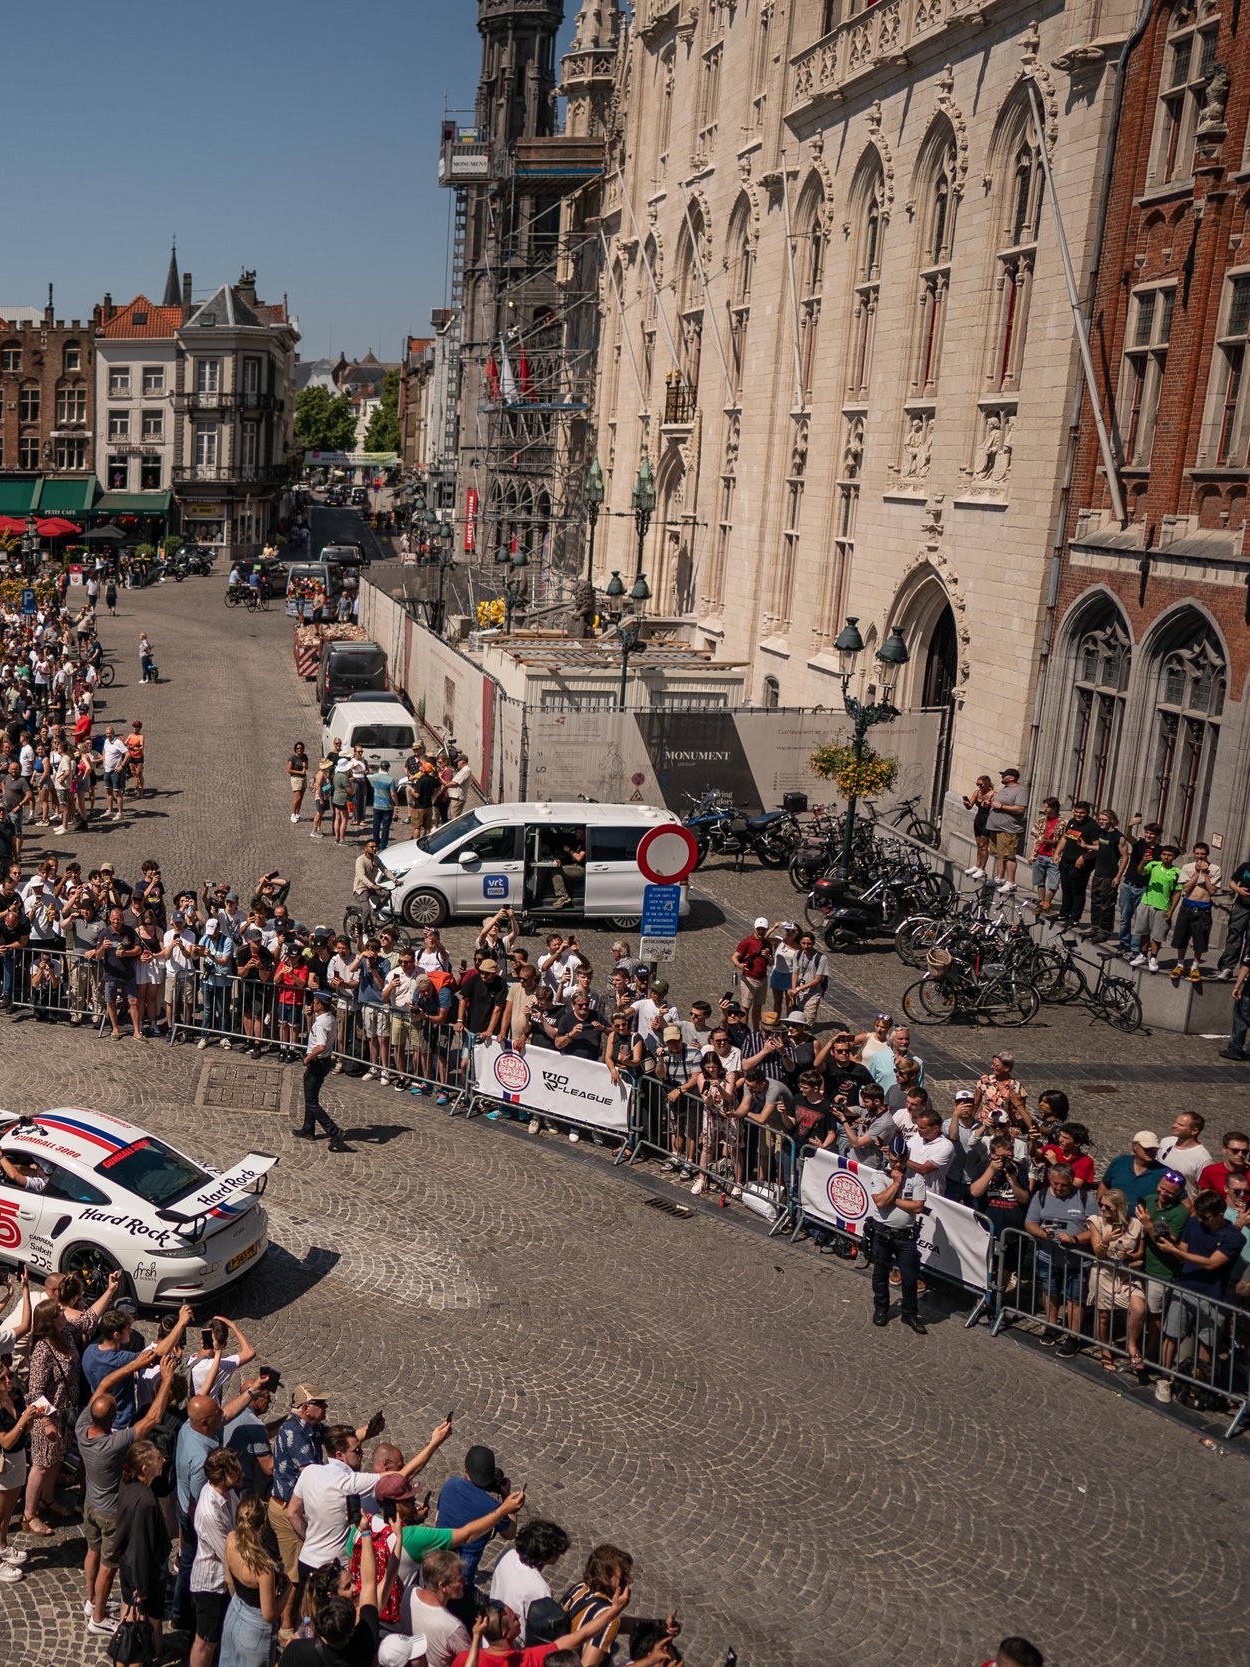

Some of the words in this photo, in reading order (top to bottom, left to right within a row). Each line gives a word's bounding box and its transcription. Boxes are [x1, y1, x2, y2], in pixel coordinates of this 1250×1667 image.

[24, 592, 34, 605] P
[665, 751, 731, 760] MONUMENT
[488, 878, 504, 887] vrt
[544, 1080, 614, 1106] R-LEAGUE
[14, 1134, 55, 1150] GUMBALL
[55, 1145, 82, 1159] 3000
[102, 1146, 134, 1169] GUMBALL
[197, 1183, 228, 1206] Hard
[226, 1169, 260, 1192] Rock
[78, 1207, 130, 1226] Hard
[124, 1217, 171, 1248] Rock
[29, 1234, 54, 1248] CARRERA
[30, 1242, 53, 1258] Sabelt
[133, 1261, 157, 1280] frsh
